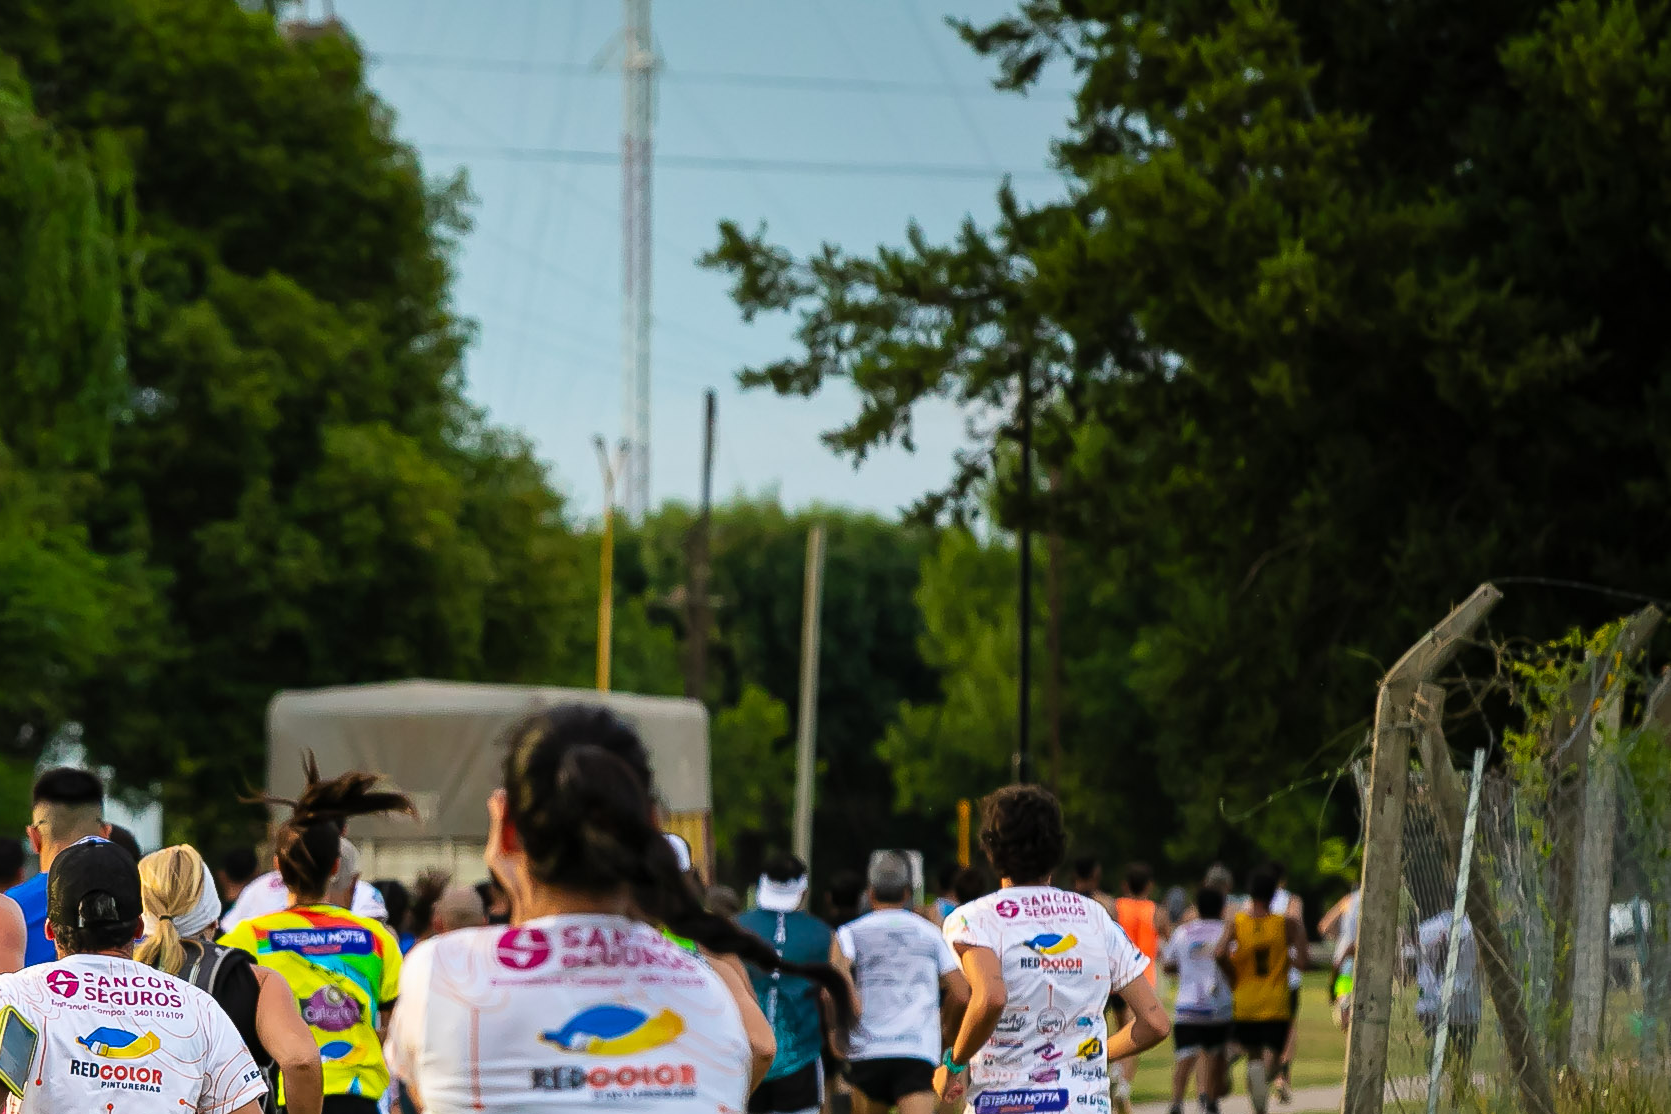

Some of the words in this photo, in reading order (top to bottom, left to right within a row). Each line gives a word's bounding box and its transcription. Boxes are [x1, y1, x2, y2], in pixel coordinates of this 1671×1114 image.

[85, 986, 182, 1008] SEGUROS
[134, 1009, 153, 1018] 3401
[70, 1059, 163, 1085] REDCOLOR
[101, 1081, 161, 1093] PINTURERIAS
